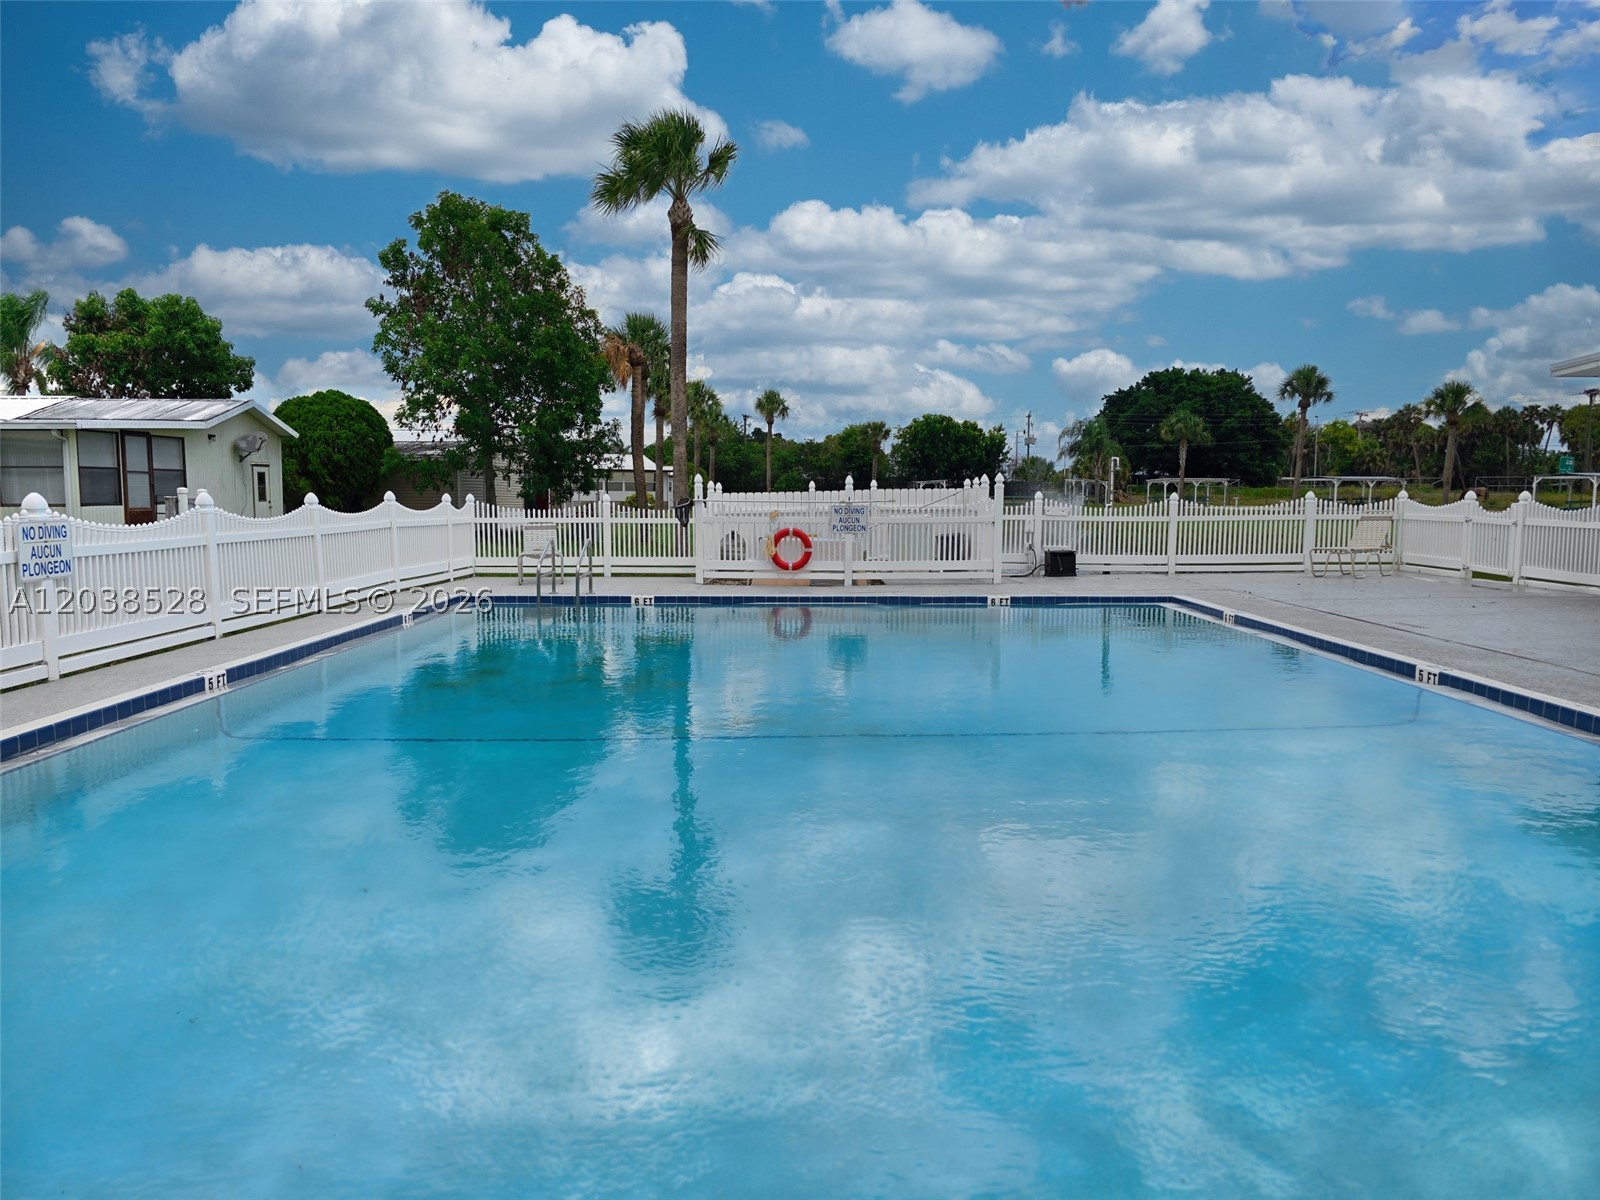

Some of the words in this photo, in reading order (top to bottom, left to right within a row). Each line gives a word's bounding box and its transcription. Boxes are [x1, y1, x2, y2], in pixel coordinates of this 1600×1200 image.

[833, 507, 843, 515] NO
[844, 507, 865, 515] DIVING
[22, 526, 36, 541] NO
[38, 525, 68, 540] DIVING
[31, 544, 62, 560] AUCUN
[22, 559, 72, 578] PLONGEON
[634, 597, 640, 606] 6
[208, 677, 214, 691] 5
[216, 673, 226, 689] FT
[1418, 669, 1424, 682] 5
[1427, 671, 1438, 686] FT
